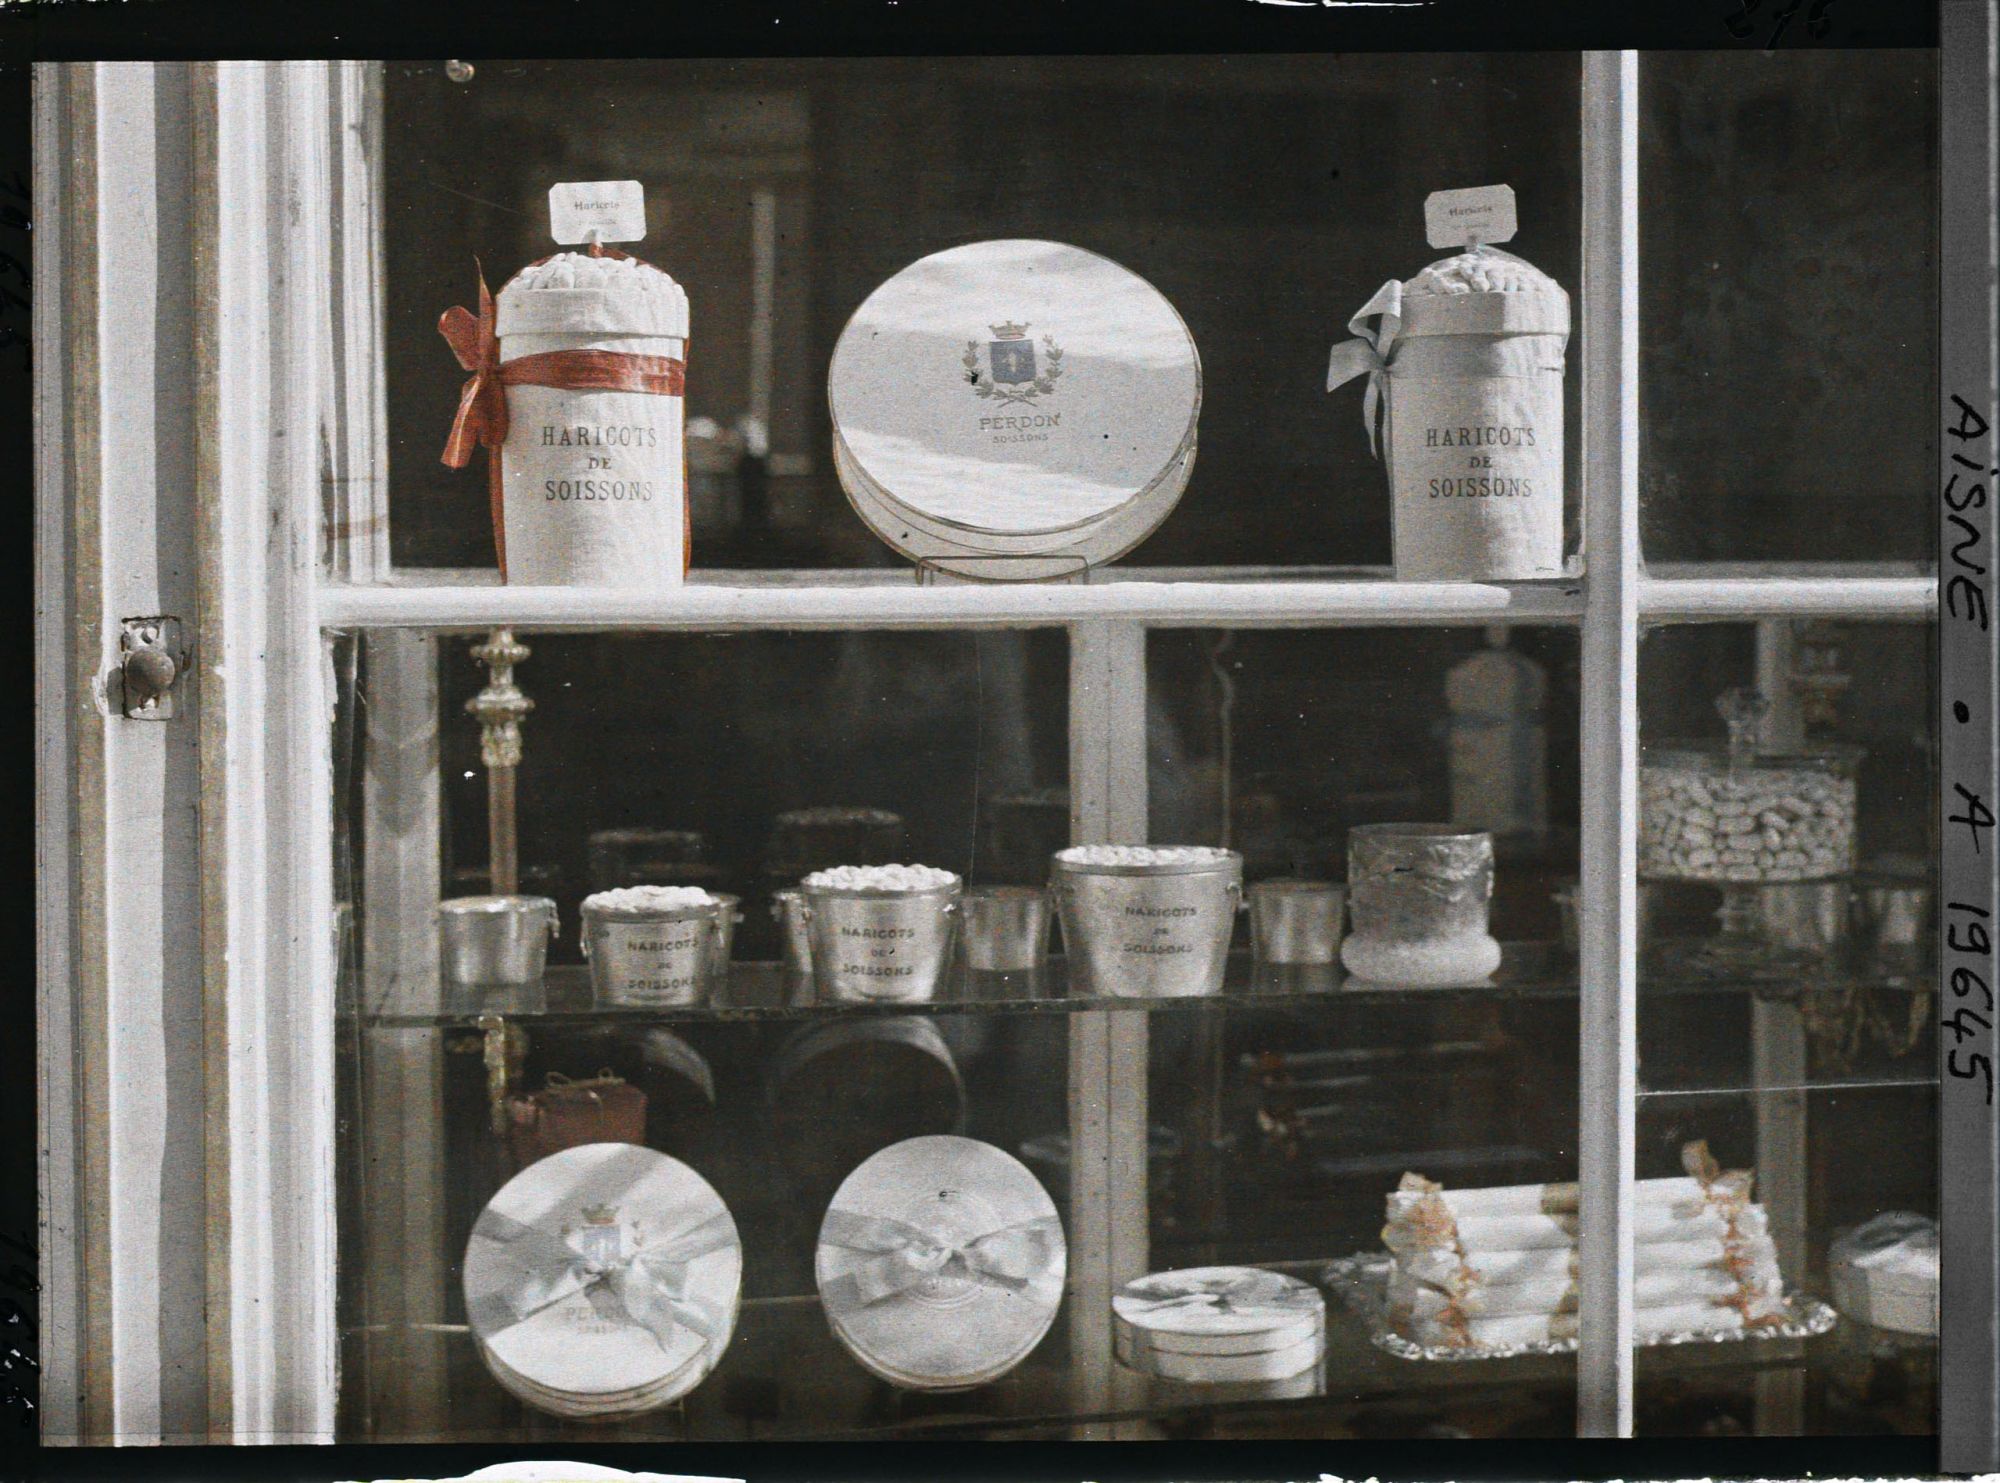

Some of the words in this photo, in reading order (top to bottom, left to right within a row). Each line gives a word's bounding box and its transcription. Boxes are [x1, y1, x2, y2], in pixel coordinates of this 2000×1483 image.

[979, 414, 1061, 432] PERDON
[541, 426, 657, 447] HARICOTS
[1426, 427, 1536, 447] HARICOTS
[588, 457, 613, 470] DE
[1469, 456, 1493, 469] DE
[545, 480, 653, 501] SOISSONS
[1429, 478, 1532, 498] SOISSONS
[1946, 781, 1997, 854] A
[842, 926, 915, 939] HARICOTS
[627, 936, 699, 951] HARICOTS
[1942, 902, 1994, 1105] 19645
